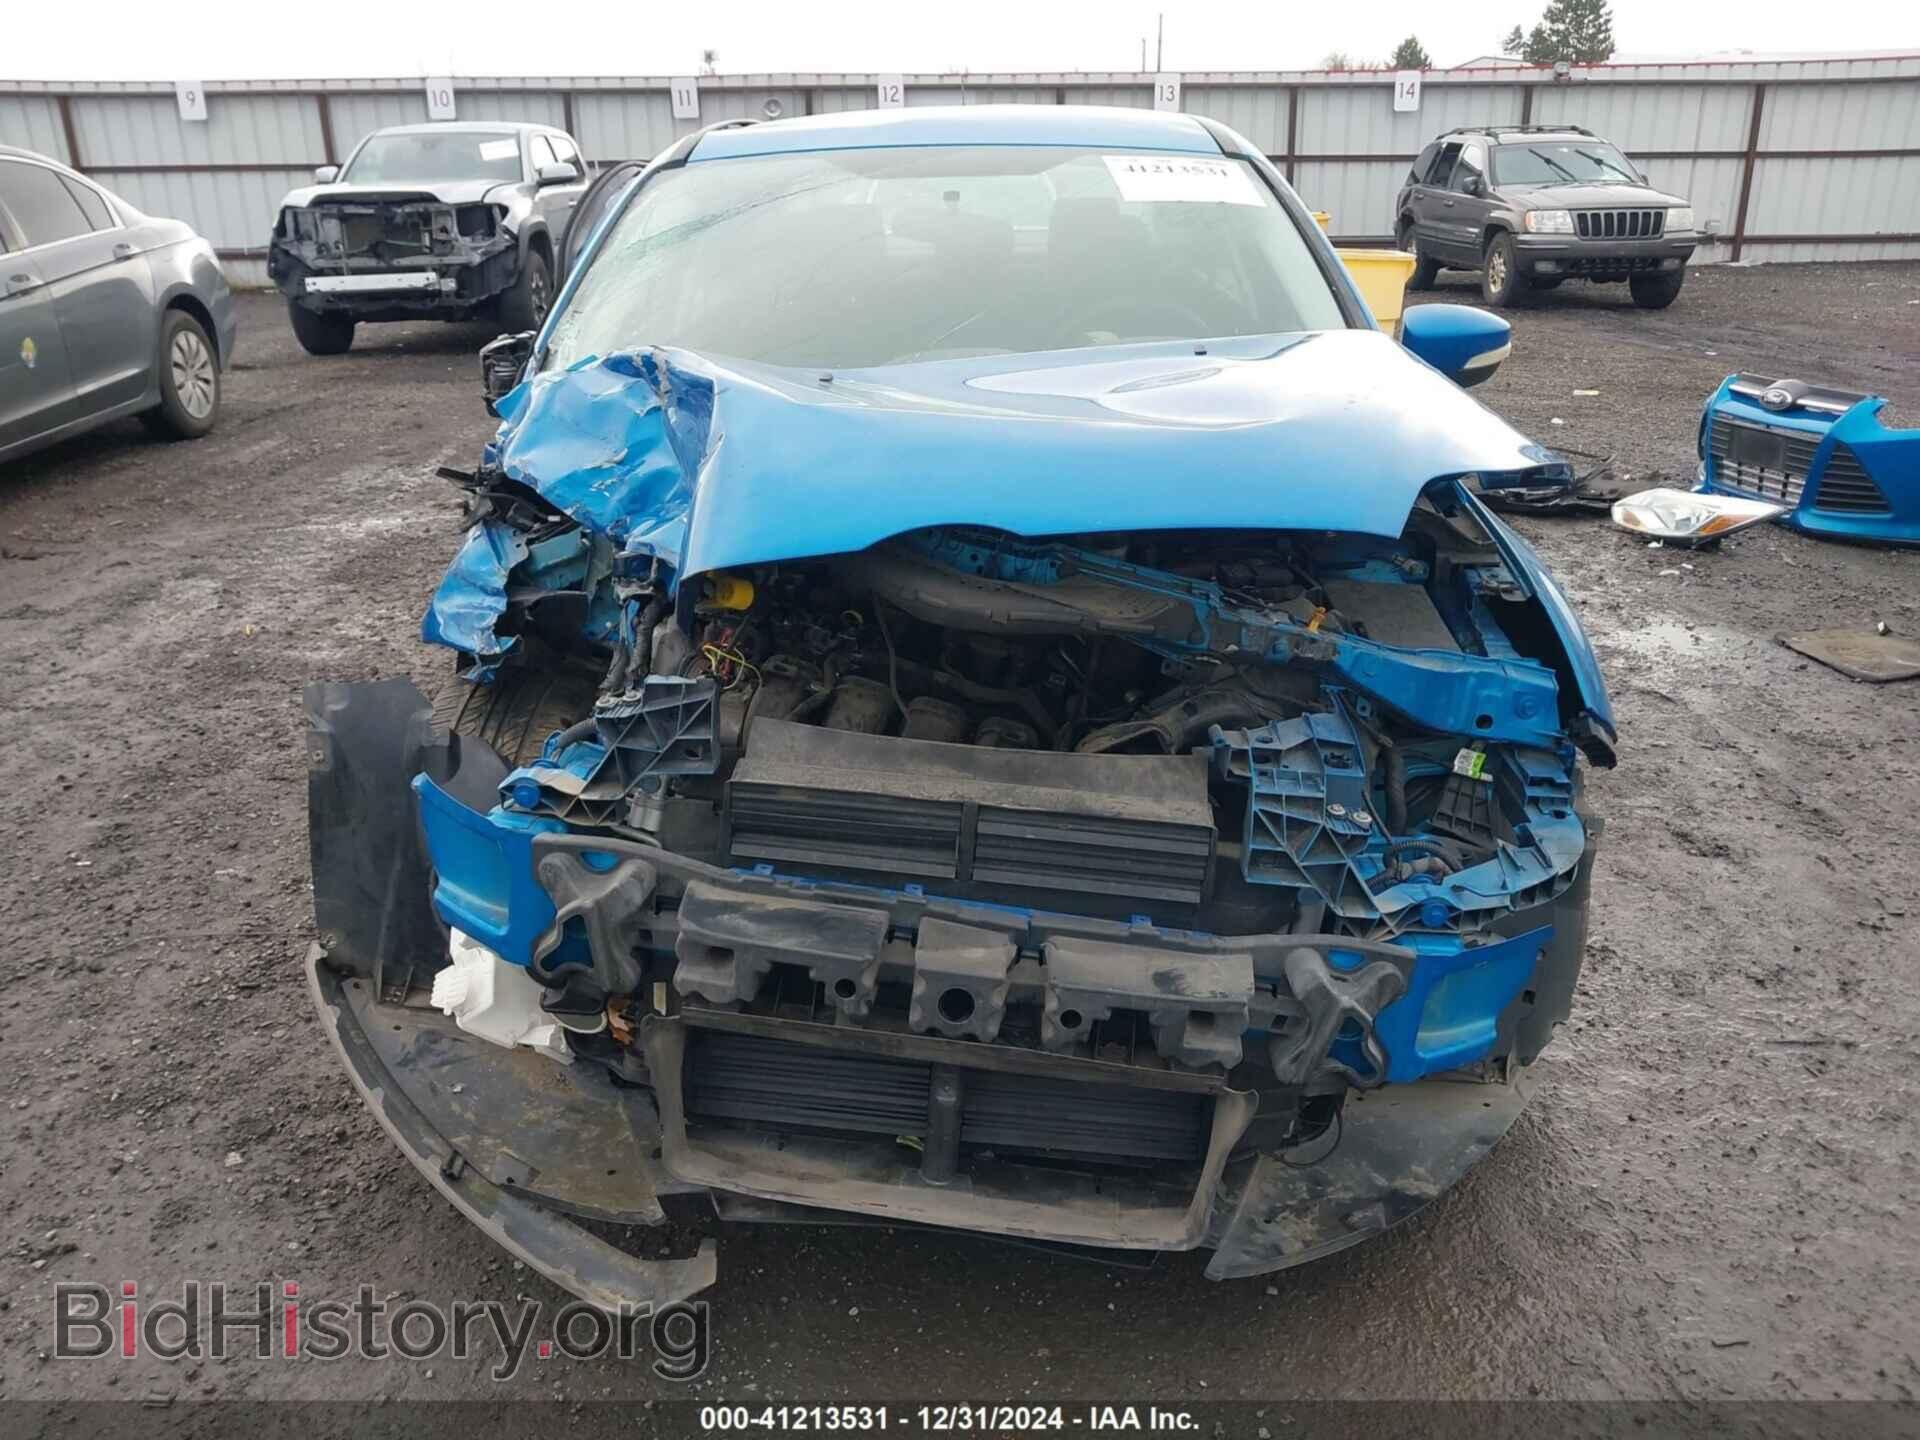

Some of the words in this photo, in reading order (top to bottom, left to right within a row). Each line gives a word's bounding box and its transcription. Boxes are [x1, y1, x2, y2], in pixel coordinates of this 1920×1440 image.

[185, 90, 196, 107] 9
[432, 89, 449, 108] 10
[678, 89, 691, 107] 11
[882, 85, 899, 103] 12
[1158, 84, 1175, 102] 13
[1399, 81, 1415, 99] 14
